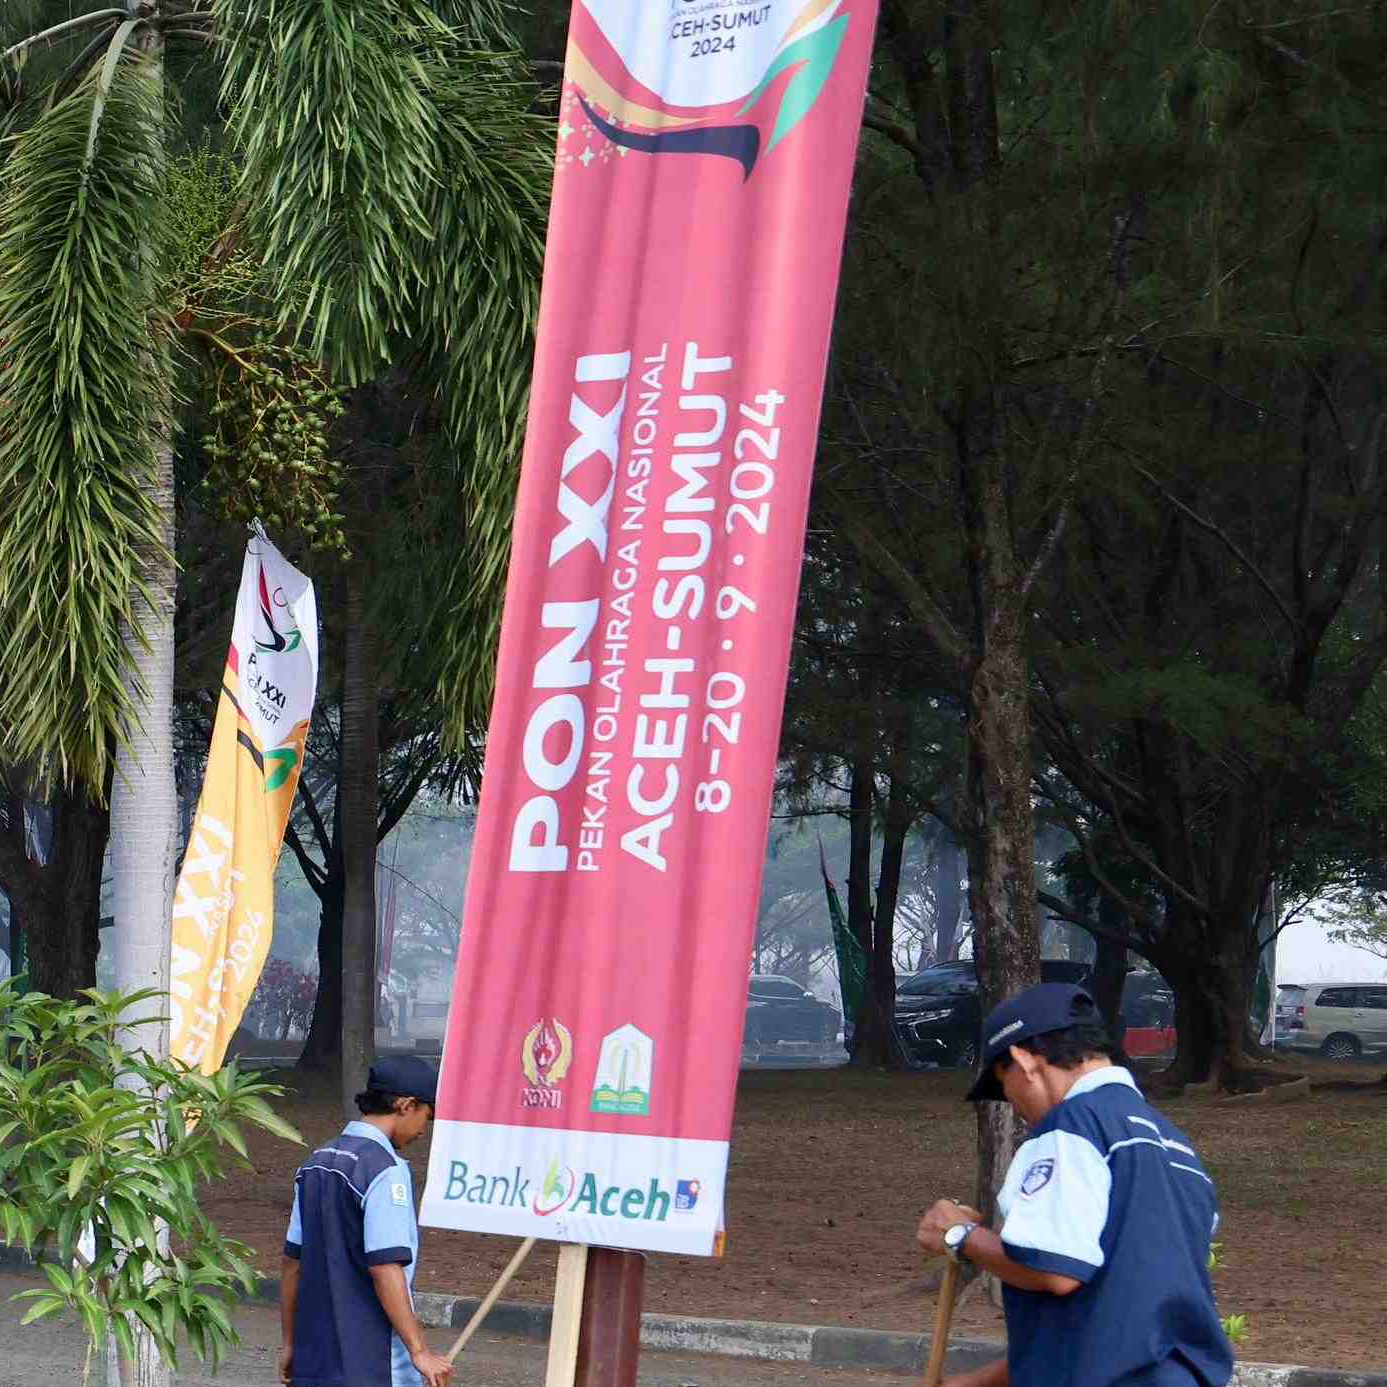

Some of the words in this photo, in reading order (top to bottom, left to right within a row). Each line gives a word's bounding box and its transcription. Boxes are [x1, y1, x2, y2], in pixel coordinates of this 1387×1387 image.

[669, 4, 772, 39] CEH-SUMUT
[690, 35, 736, 58] 2024
[548, 350, 633, 568] XXI
[619, 343, 667, 530] NASIONAL
[724, 389, 787, 536] 2024
[592, 540, 641, 741] OLAHRAGA
[619, 341, 733, 872] ACEH-SUMUT
[508, 598, 602, 872] PON
[577, 751, 613, 872] PEKAN
[443, 1160, 530, 1209] Bank
[569, 1172, 671, 1222] Aceh
